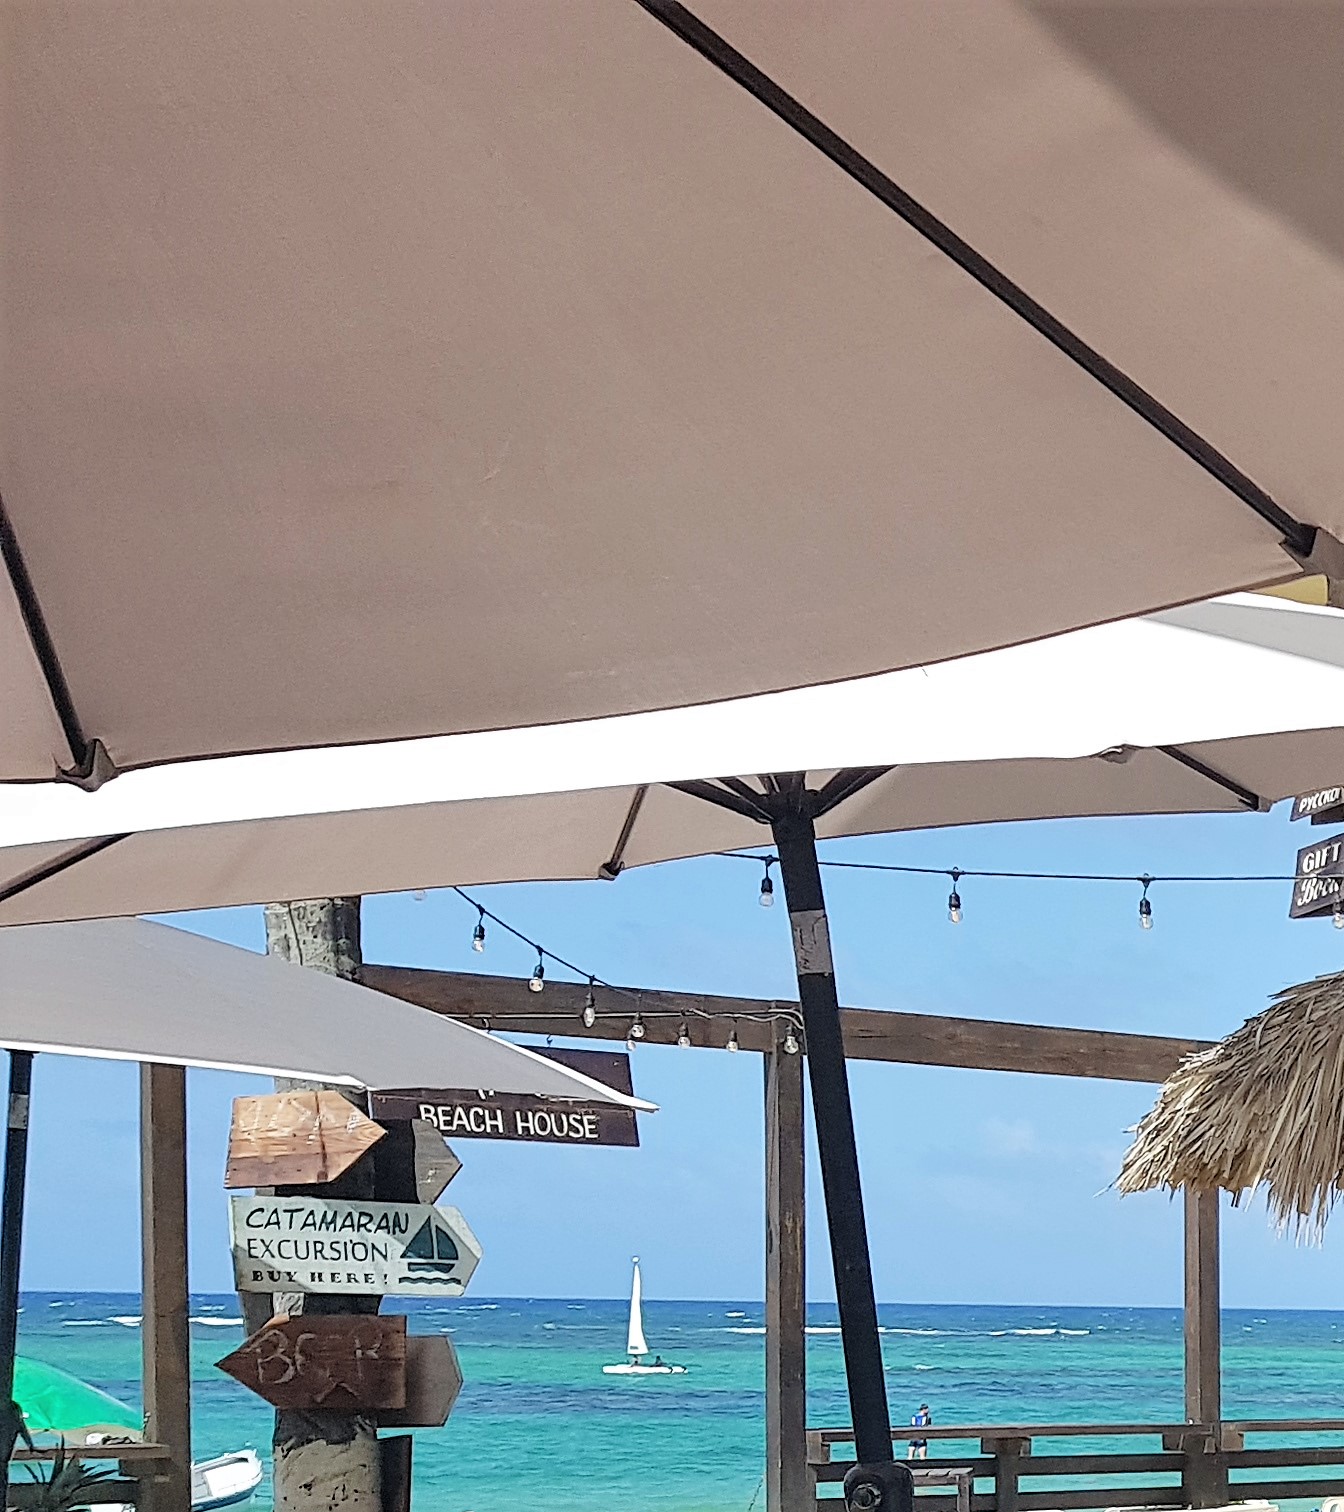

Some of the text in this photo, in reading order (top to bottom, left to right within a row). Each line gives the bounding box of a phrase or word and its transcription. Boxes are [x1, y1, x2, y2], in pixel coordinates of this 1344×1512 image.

[1302, 842, 1341, 873] GIFT
[419, 1103, 599, 1139] BEACH HOUSE
[245, 1207, 409, 1236] CATAMARAN
[247, 1238, 389, 1262] EXCURSION
[252, 1270, 389, 1285] BUY HERE!
